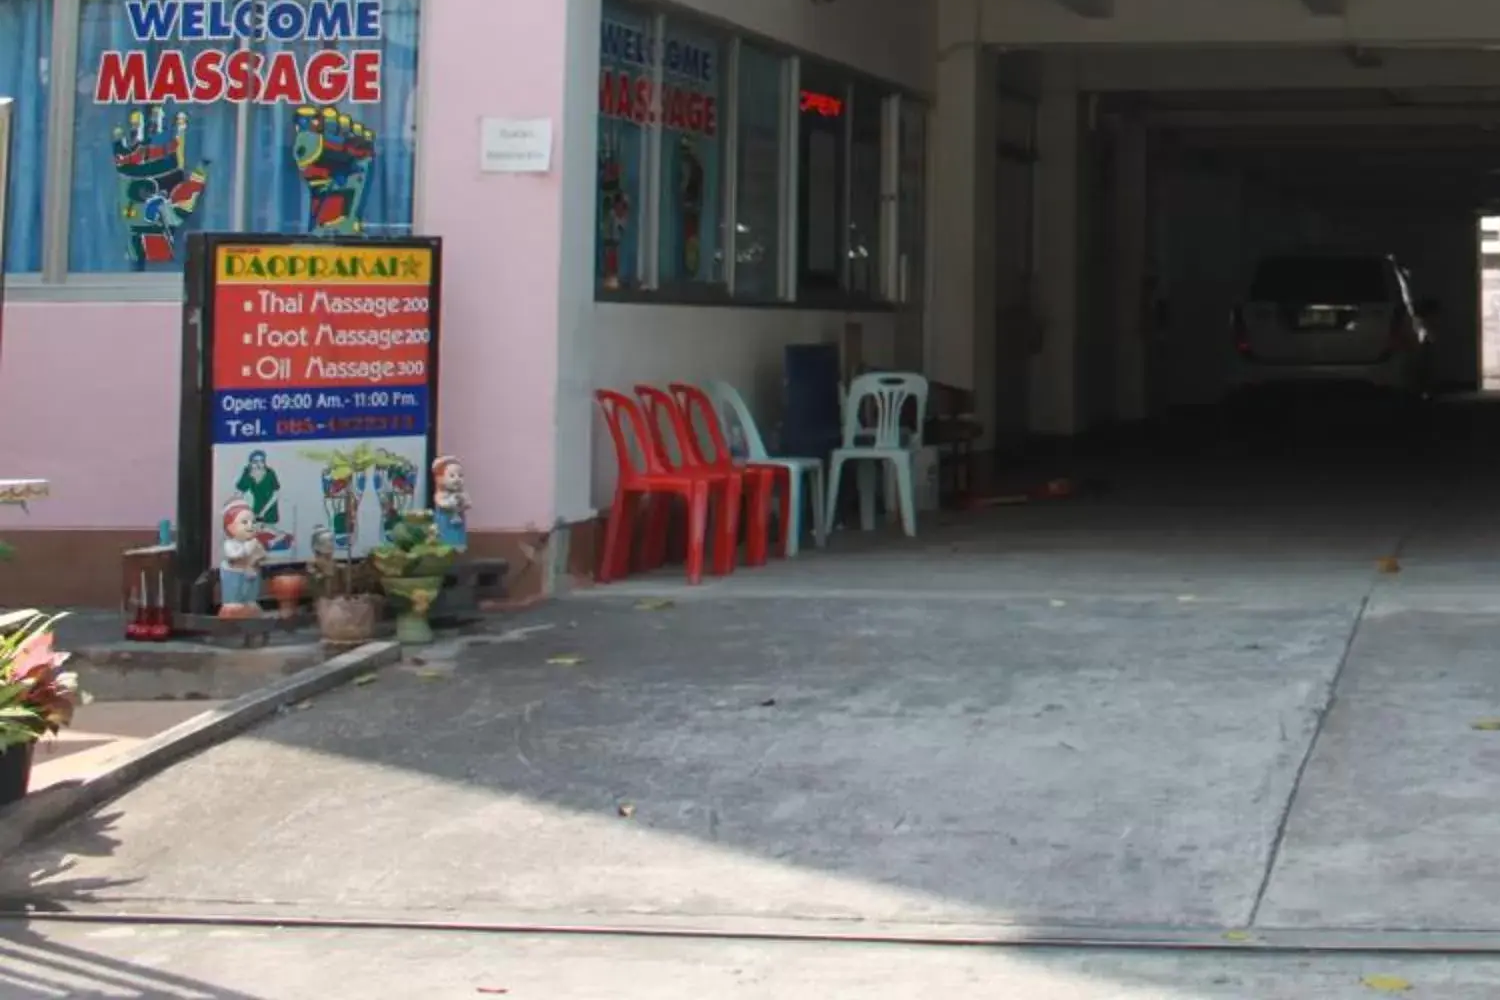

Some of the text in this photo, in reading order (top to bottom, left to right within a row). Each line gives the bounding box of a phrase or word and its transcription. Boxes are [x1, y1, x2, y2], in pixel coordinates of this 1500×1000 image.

[601, 18, 712, 83] WELOME
[95, 50, 382, 104] MASSAGE
[258, 289, 429, 318] Thai Massage 200
[257, 323, 431, 349] Foot Massage 200
[256, 356, 424, 382] Oil Massage 300
[222, 395, 267, 413] Open:
[271, 394, 312, 410] 09:00
[353, 392, 389, 407] 11:00
[226, 419, 267, 437] Tel.
